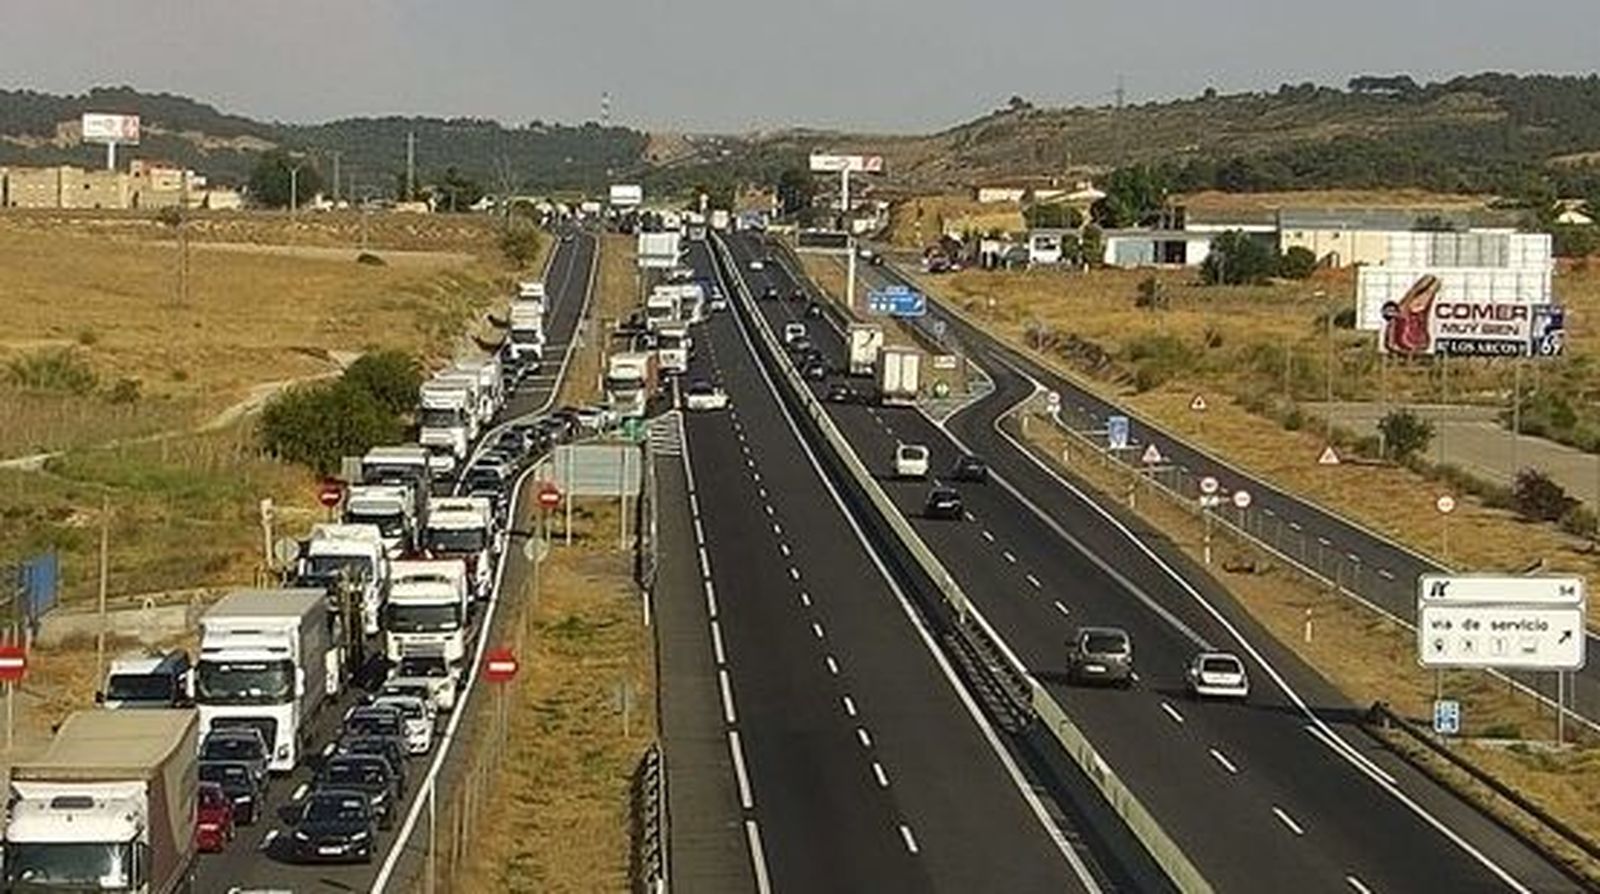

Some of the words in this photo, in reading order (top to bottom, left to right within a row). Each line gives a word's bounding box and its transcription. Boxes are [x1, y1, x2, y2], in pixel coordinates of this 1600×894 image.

[1435, 303, 1528, 320] COMER
[1440, 324, 1479, 334] MUY
[1462, 619, 1480, 630] de
[1491, 618, 1548, 631] servicio
